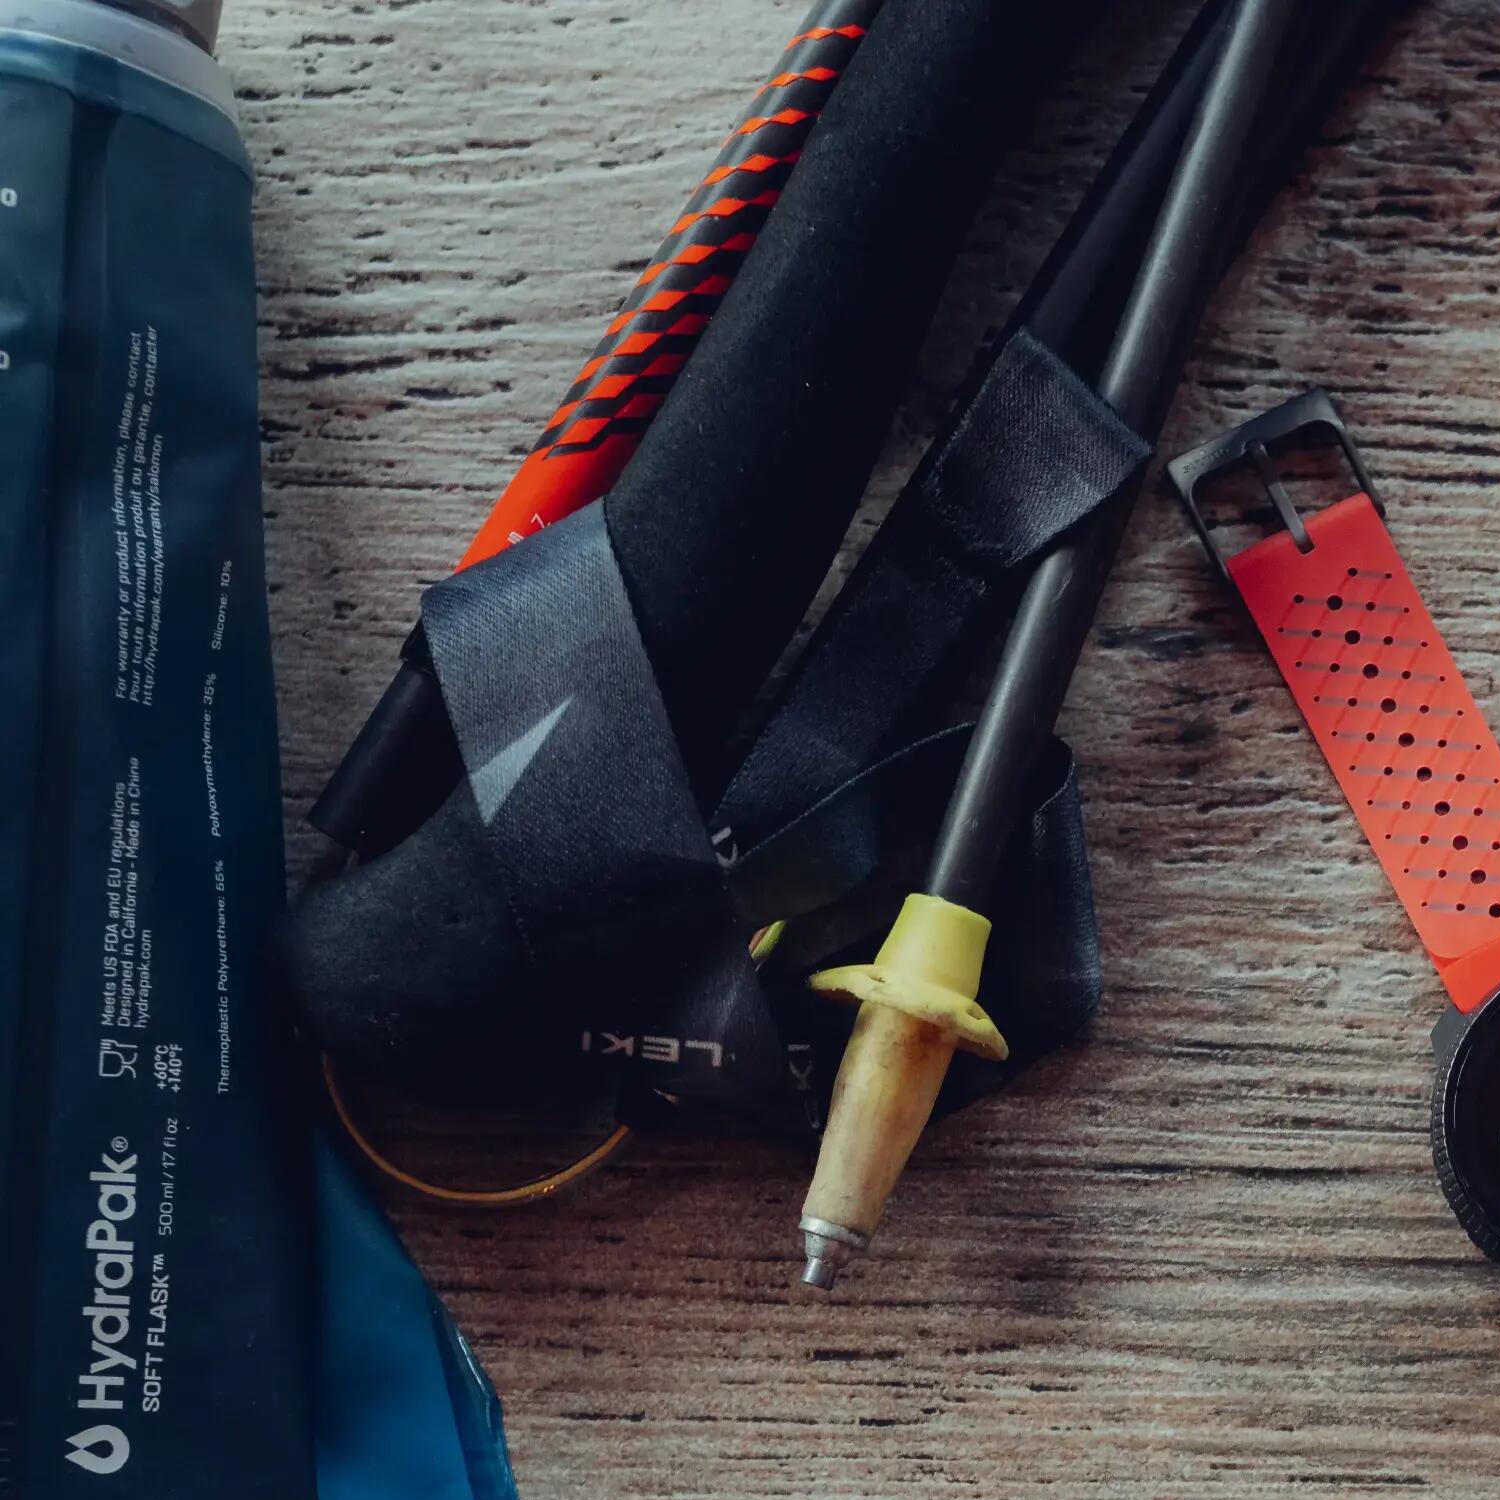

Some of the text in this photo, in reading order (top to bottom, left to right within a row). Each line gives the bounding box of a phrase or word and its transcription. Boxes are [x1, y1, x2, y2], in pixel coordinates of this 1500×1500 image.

[111, 330, 142, 698] For warranty or product information, please contact
[129, 324, 158, 701] Pour toute information produit ou garantie, contacter
[142, 432, 164, 706] http://hydrapak.com/warranty/salomon
[211, 558, 233, 649] Silicone: 10%
[128, 756, 141, 797] China
[201, 672, 222, 836] Polyoxymethylene: 35%
[125, 819, 140, 857] Made
[127, 802, 140, 814] in
[101, 781, 127, 1025] Meets US FDA and EU regulations
[121, 870, 138, 938] California
[121, 943, 135, 955] in
[133, 928, 153, 1027] hydrapak.com
[213, 858, 231, 1093] Thermoplastic Polyurethane: 55%
[118, 960, 135, 1026] Designed
[582, 1030, 722, 1068] LEKI
[164, 1136, 177, 1147] fl
[166, 1117, 179, 1133] oz
[160, 1181, 174, 1198] ml
[162, 1151, 176, 1167] 17
[159, 1201, 174, 1235] 500
[142, 1351, 164, 1412] SOFT
